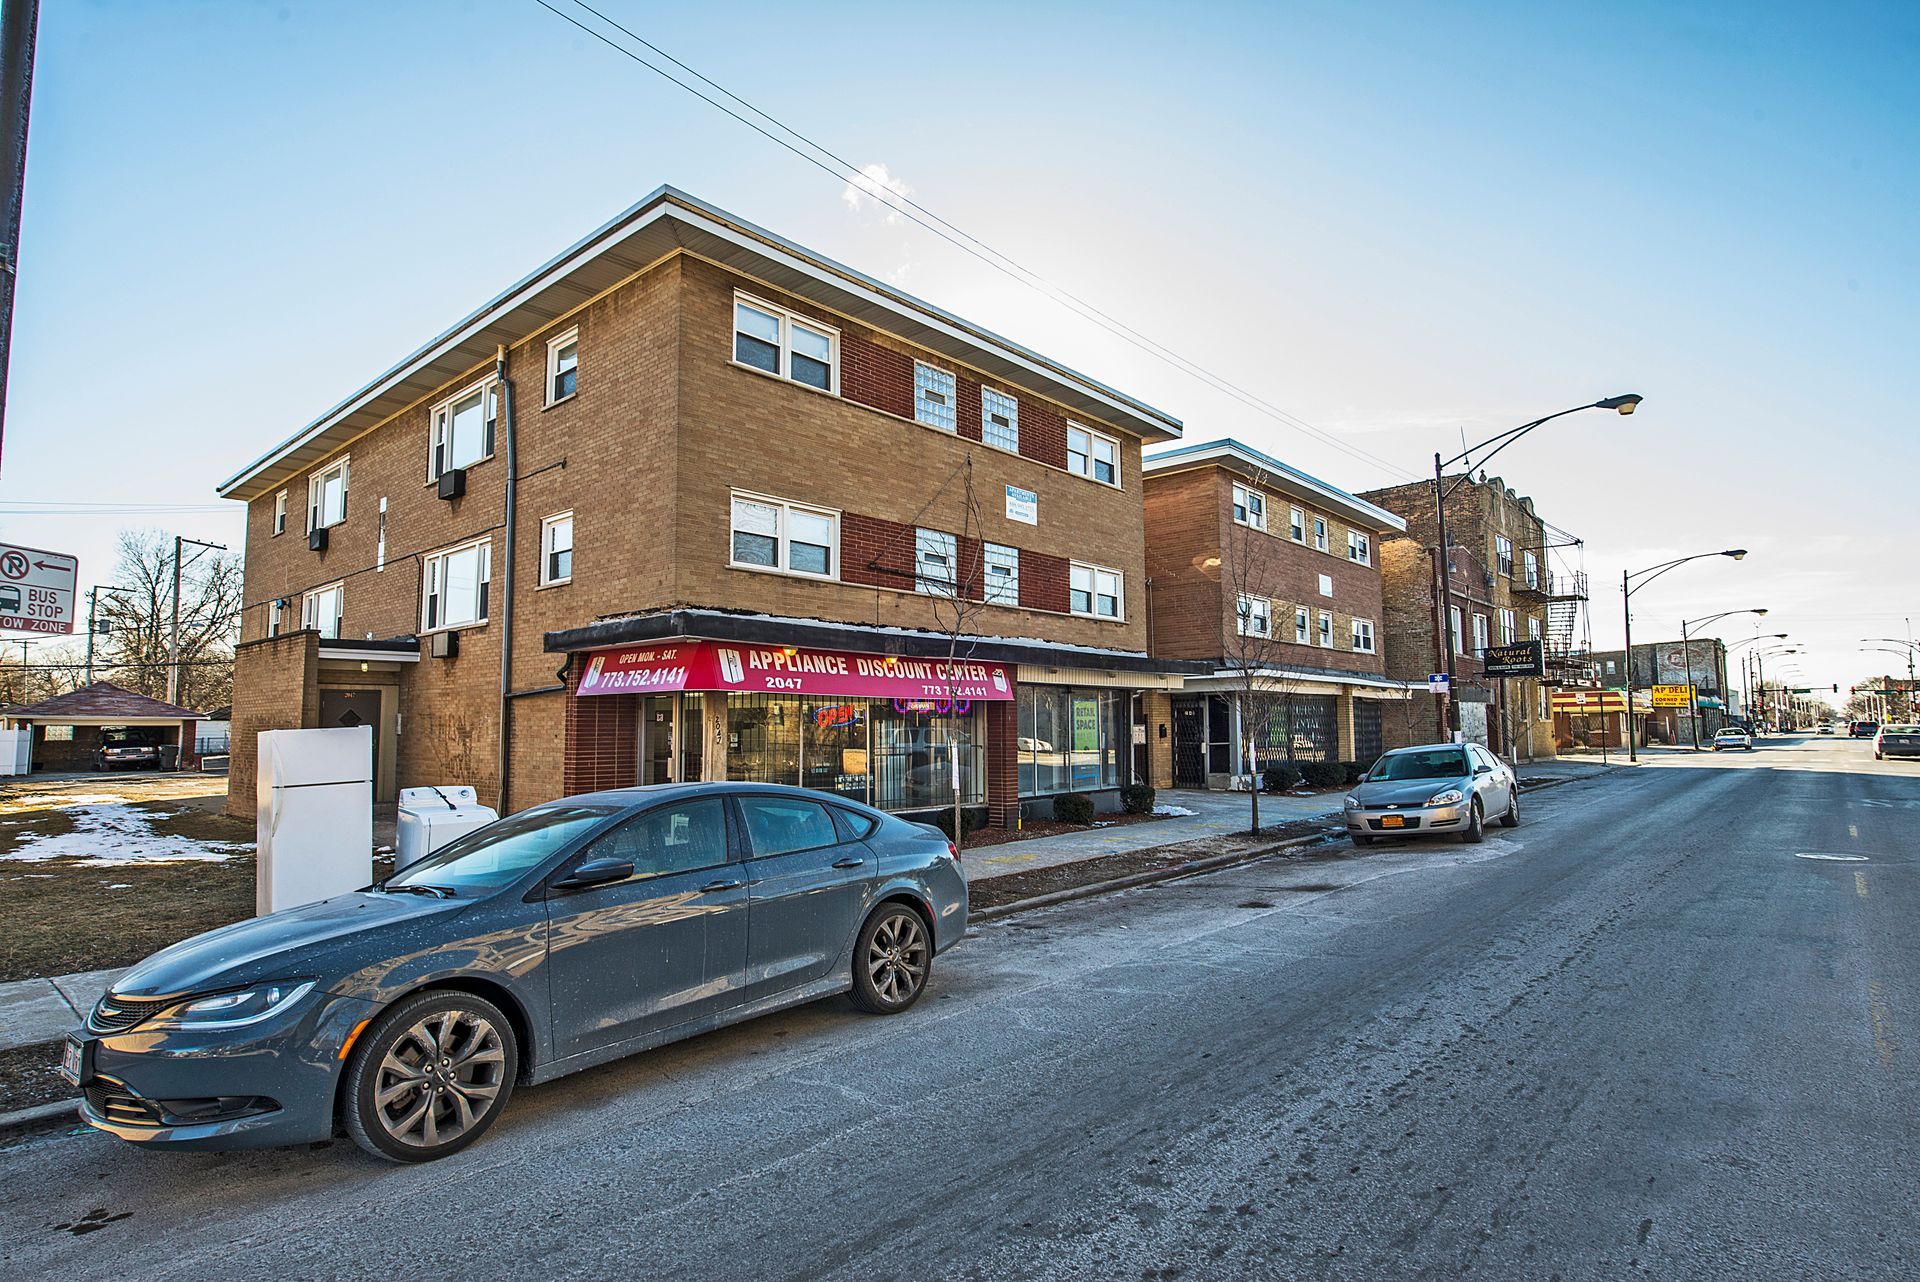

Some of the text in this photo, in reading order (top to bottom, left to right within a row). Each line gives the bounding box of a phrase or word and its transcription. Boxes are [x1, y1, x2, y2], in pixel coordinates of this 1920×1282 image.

[28, 589, 57, 604] BUS
[27, 603, 64, 618] STOP
[31, 620, 67, 633] ZONE
[619, 653, 638, 664] OPEN
[637, 652, 655, 663] MON.
[661, 649, 678, 660] SAT.
[1488, 647, 1532, 658] Natural
[749, 650, 989, 682] APPLIANCE DISCOUNT CENTER
[1502, 656, 1533, 664] Roots
[600, 666, 685, 689] 773.752.4141
[765, 676, 802, 690] 2047
[1668, 686, 1688, 694] DELI
[817, 703, 855, 728] OPEN
[1076, 707, 1096, 717] RETAIL
[1076, 719, 1096, 730] SPACE
